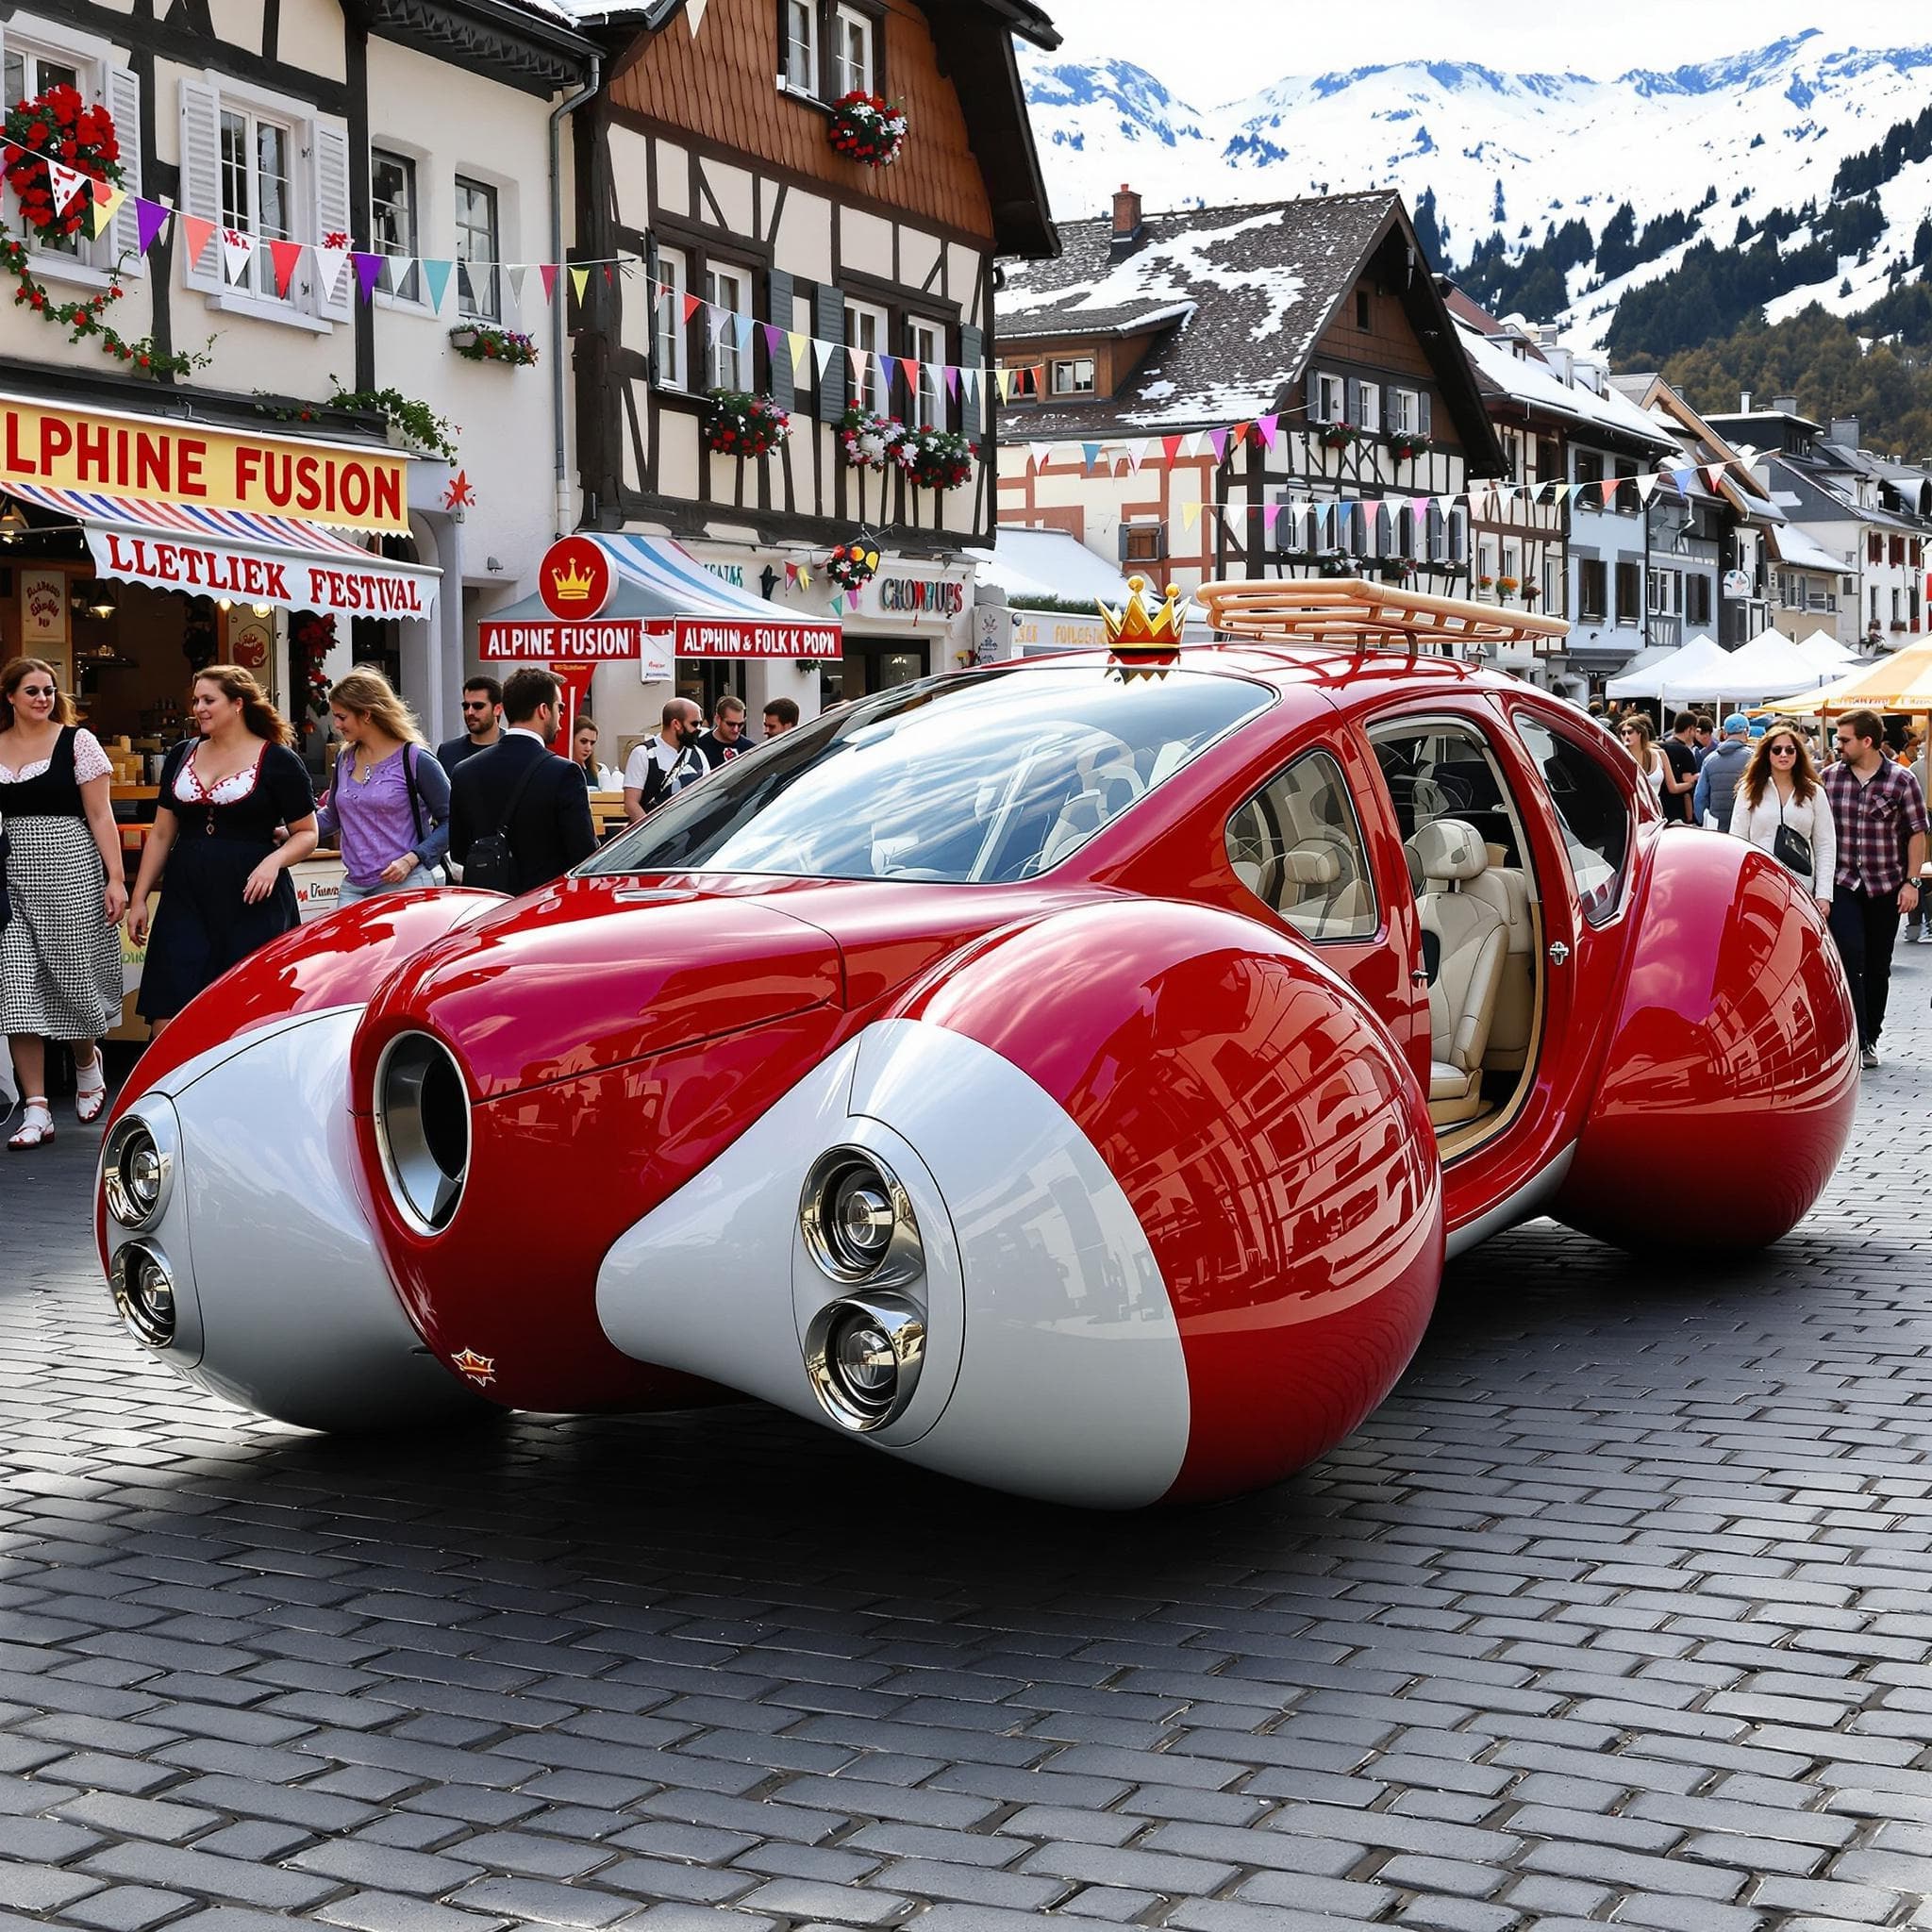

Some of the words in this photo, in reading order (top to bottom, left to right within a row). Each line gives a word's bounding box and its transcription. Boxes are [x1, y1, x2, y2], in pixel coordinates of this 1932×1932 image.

[7, 411, 208, 496] LPHINE
[236, 446, 400, 521] FUSION
[106, 534, 292, 600] LLETLIEK
[308, 568, 422, 611] FESTIVAL
[488, 628, 556, 657] ALPINE
[560, 627, 629, 656] FUSION
[742, 634, 753, 652] &
[755, 628, 789, 654] FOLK
[791, 629, 800, 654] K
